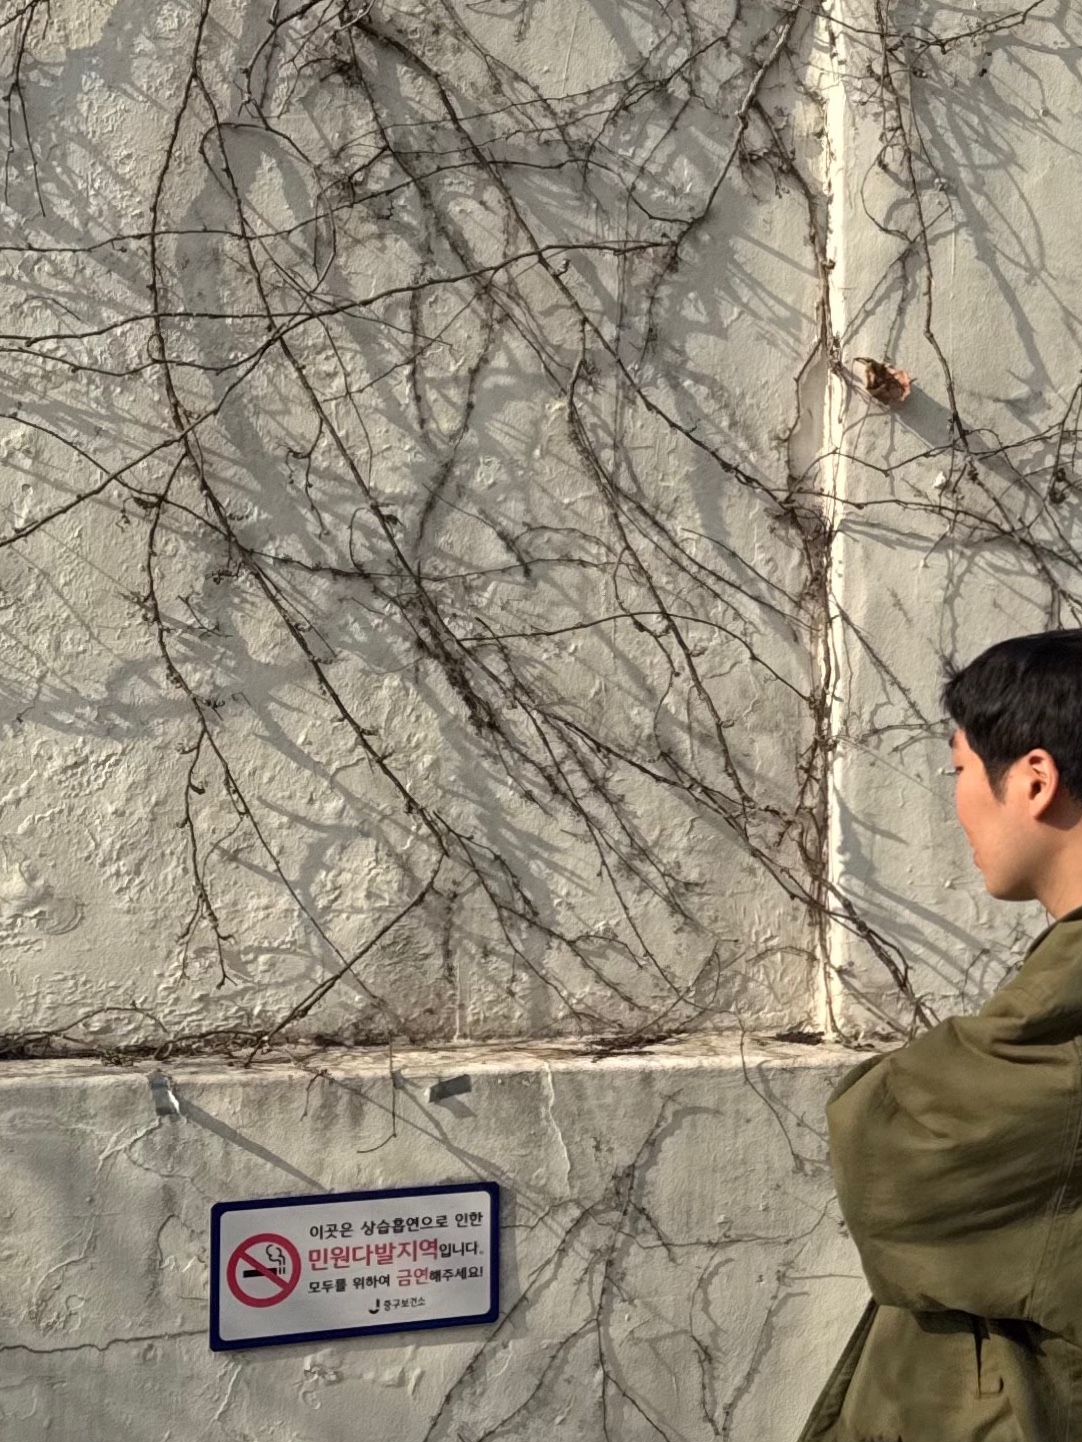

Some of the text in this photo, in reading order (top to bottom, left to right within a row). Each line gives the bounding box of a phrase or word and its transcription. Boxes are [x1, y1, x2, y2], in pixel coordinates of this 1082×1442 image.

[309, 1211, 484, 1241] 이곳은 상습흡연으로 인한
[308, 1238, 484, 1271] 민원다발지역입니다.
[307, 1267, 484, 1295] 모두를 위하여 금연해주세요!
